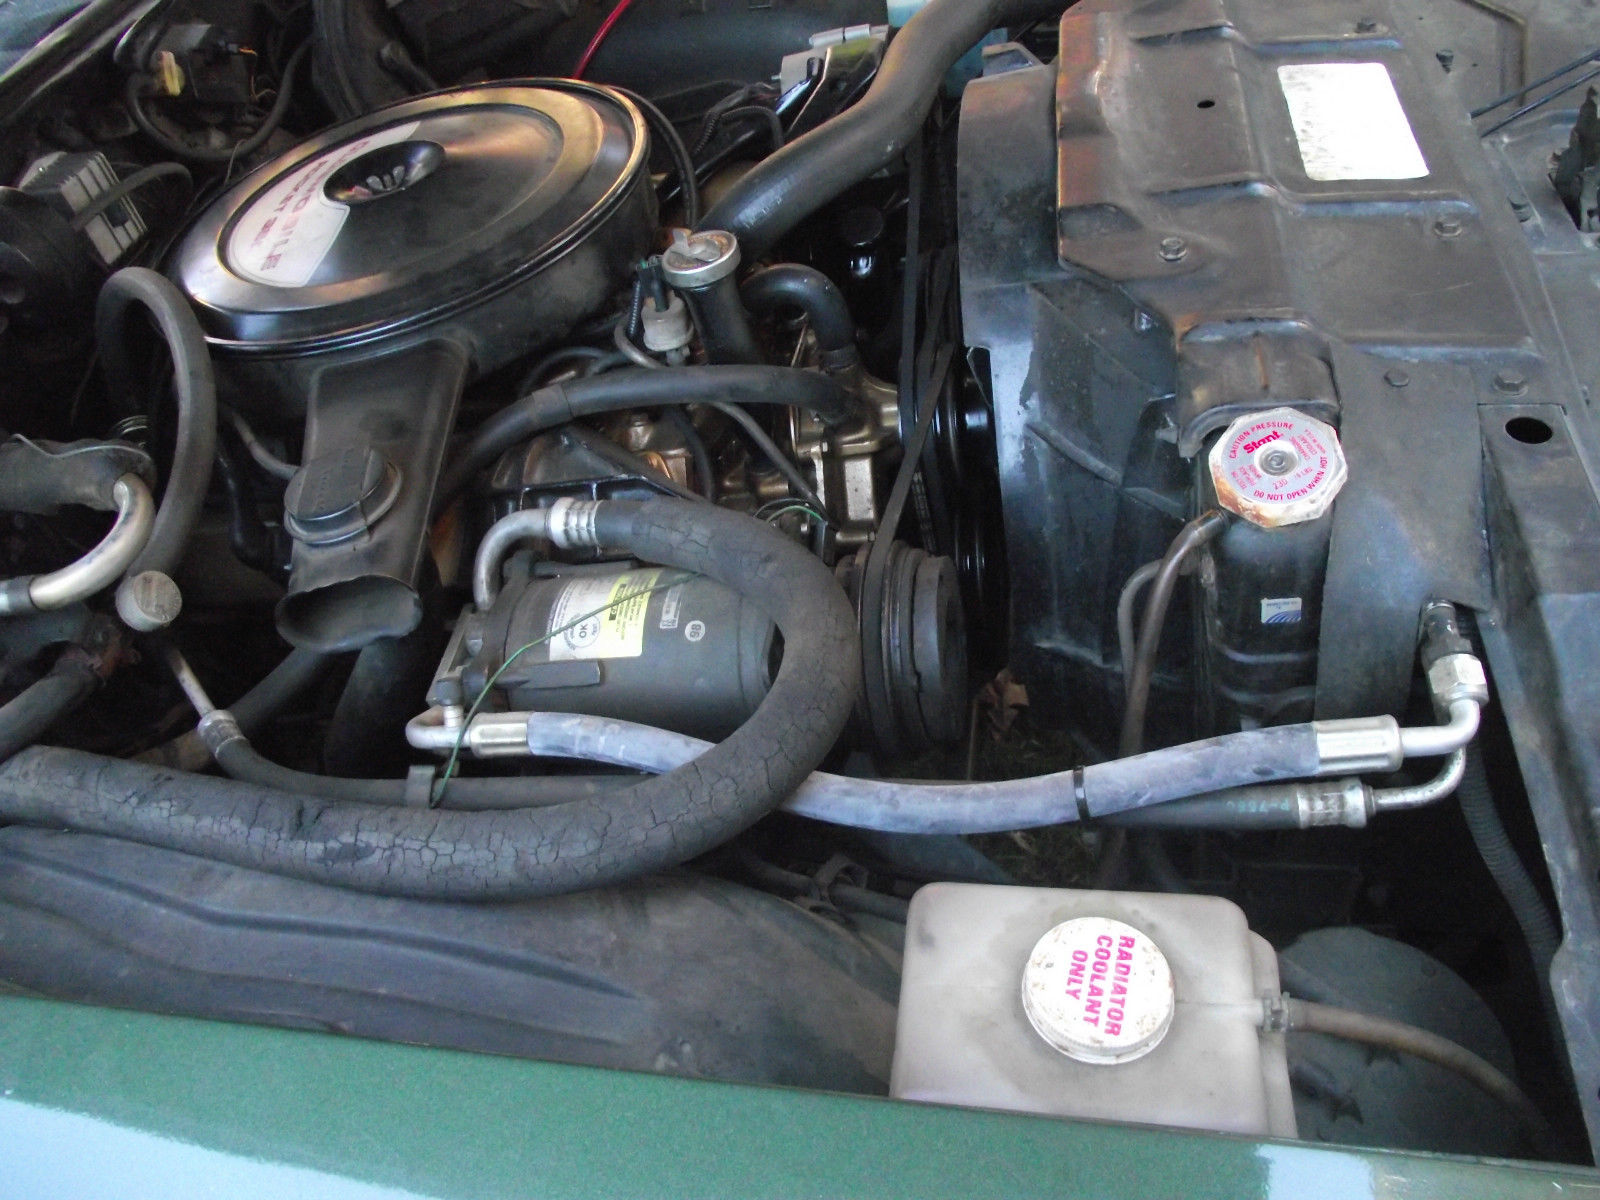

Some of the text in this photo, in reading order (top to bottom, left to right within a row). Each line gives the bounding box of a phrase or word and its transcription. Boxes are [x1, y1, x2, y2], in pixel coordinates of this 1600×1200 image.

[1229, 421, 1294, 459] CAUTION PRESSURE
[1243, 430, 1282, 454] Stant
[1253, 489, 1265, 498] DO
[1287, 488, 1308, 500] OPEN
[1307, 470, 1325, 490] WHEN
[1320, 456, 1328, 469] HOT
[579, 623, 589, 639] OK
[689, 623, 702, 639] 98
[1065, 950, 1088, 1000] ONLY
[1083, 934, 1113, 1027] COOLANT
[1104, 935, 1136, 1037] RADIATOR
